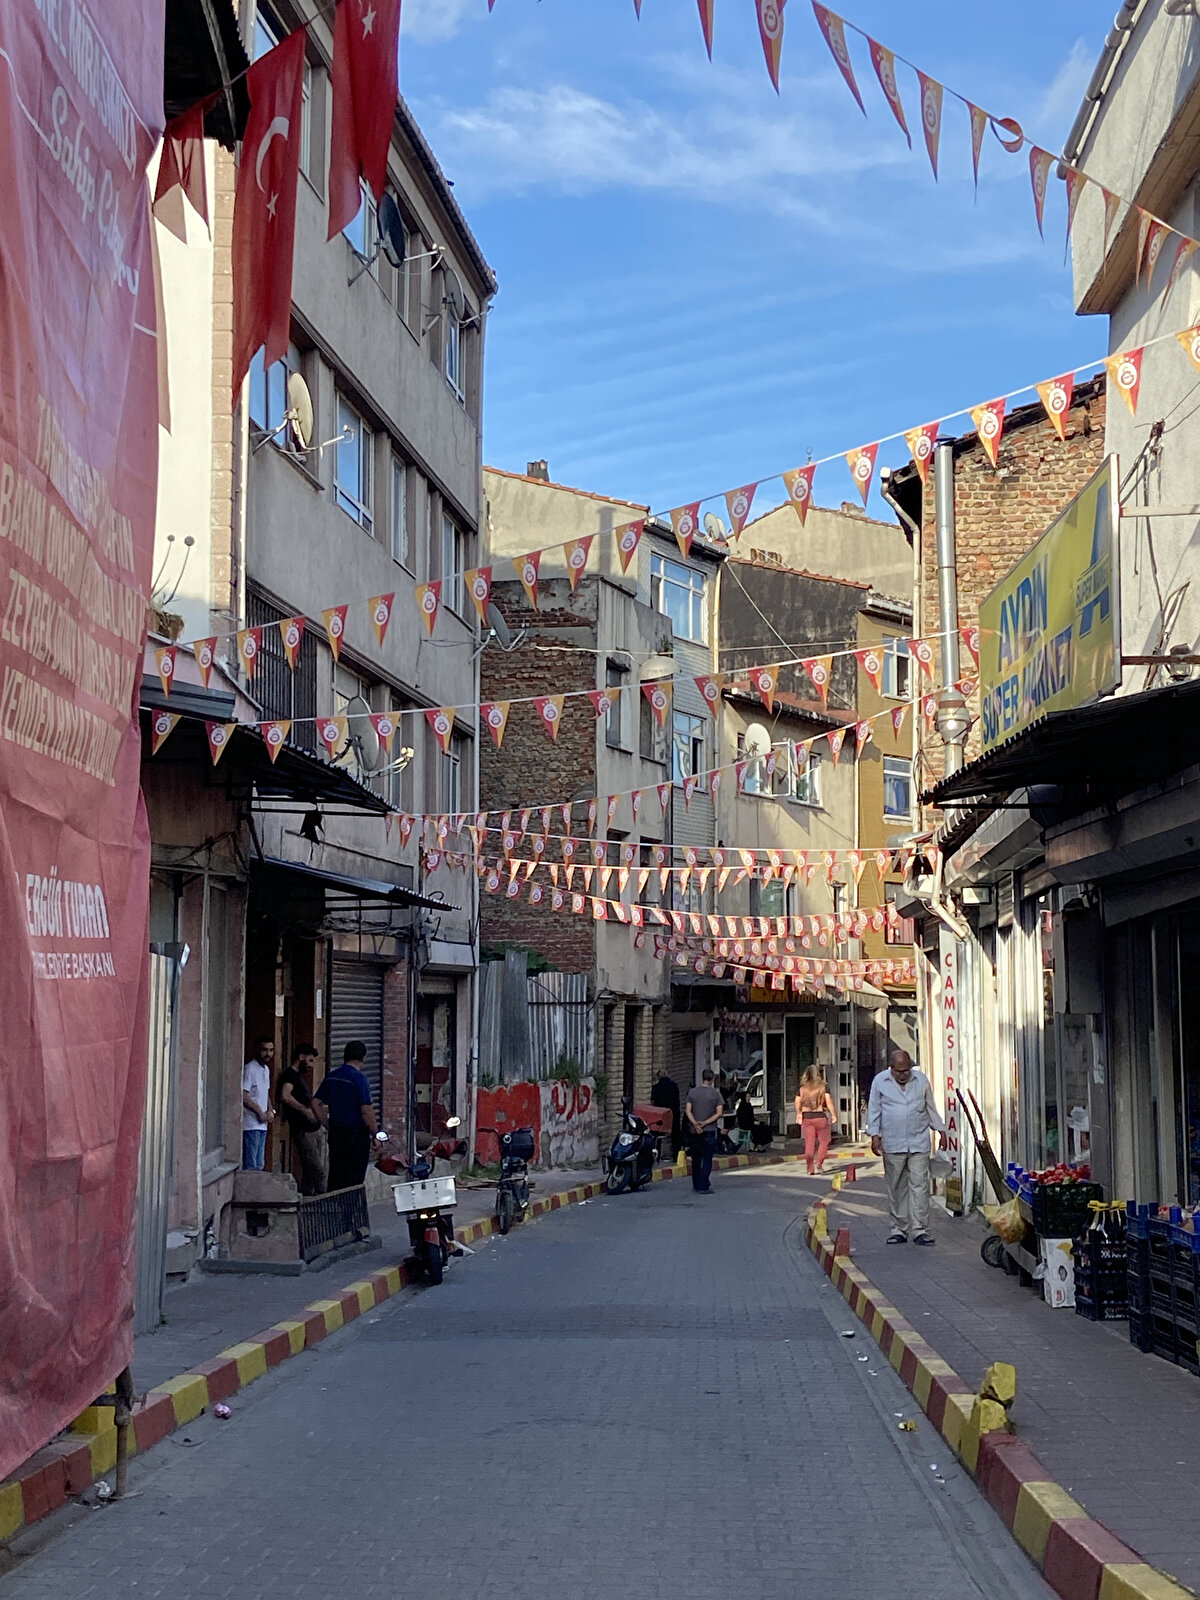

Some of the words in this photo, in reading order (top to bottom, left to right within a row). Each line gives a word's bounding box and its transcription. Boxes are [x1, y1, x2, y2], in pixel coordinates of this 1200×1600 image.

[50, 85, 96, 222] Sahip
[2, 567, 57, 666] ZEYREK
[998, 555, 1047, 673] AYDIN
[0, 665, 56, 757] YENİDEN
[983, 678, 1019, 745] SÜPER
[26, 865, 63, 938] ERGÜN
[63, 880, 110, 938] TURAN
[71, 951, 116, 984] BAŞKANI
